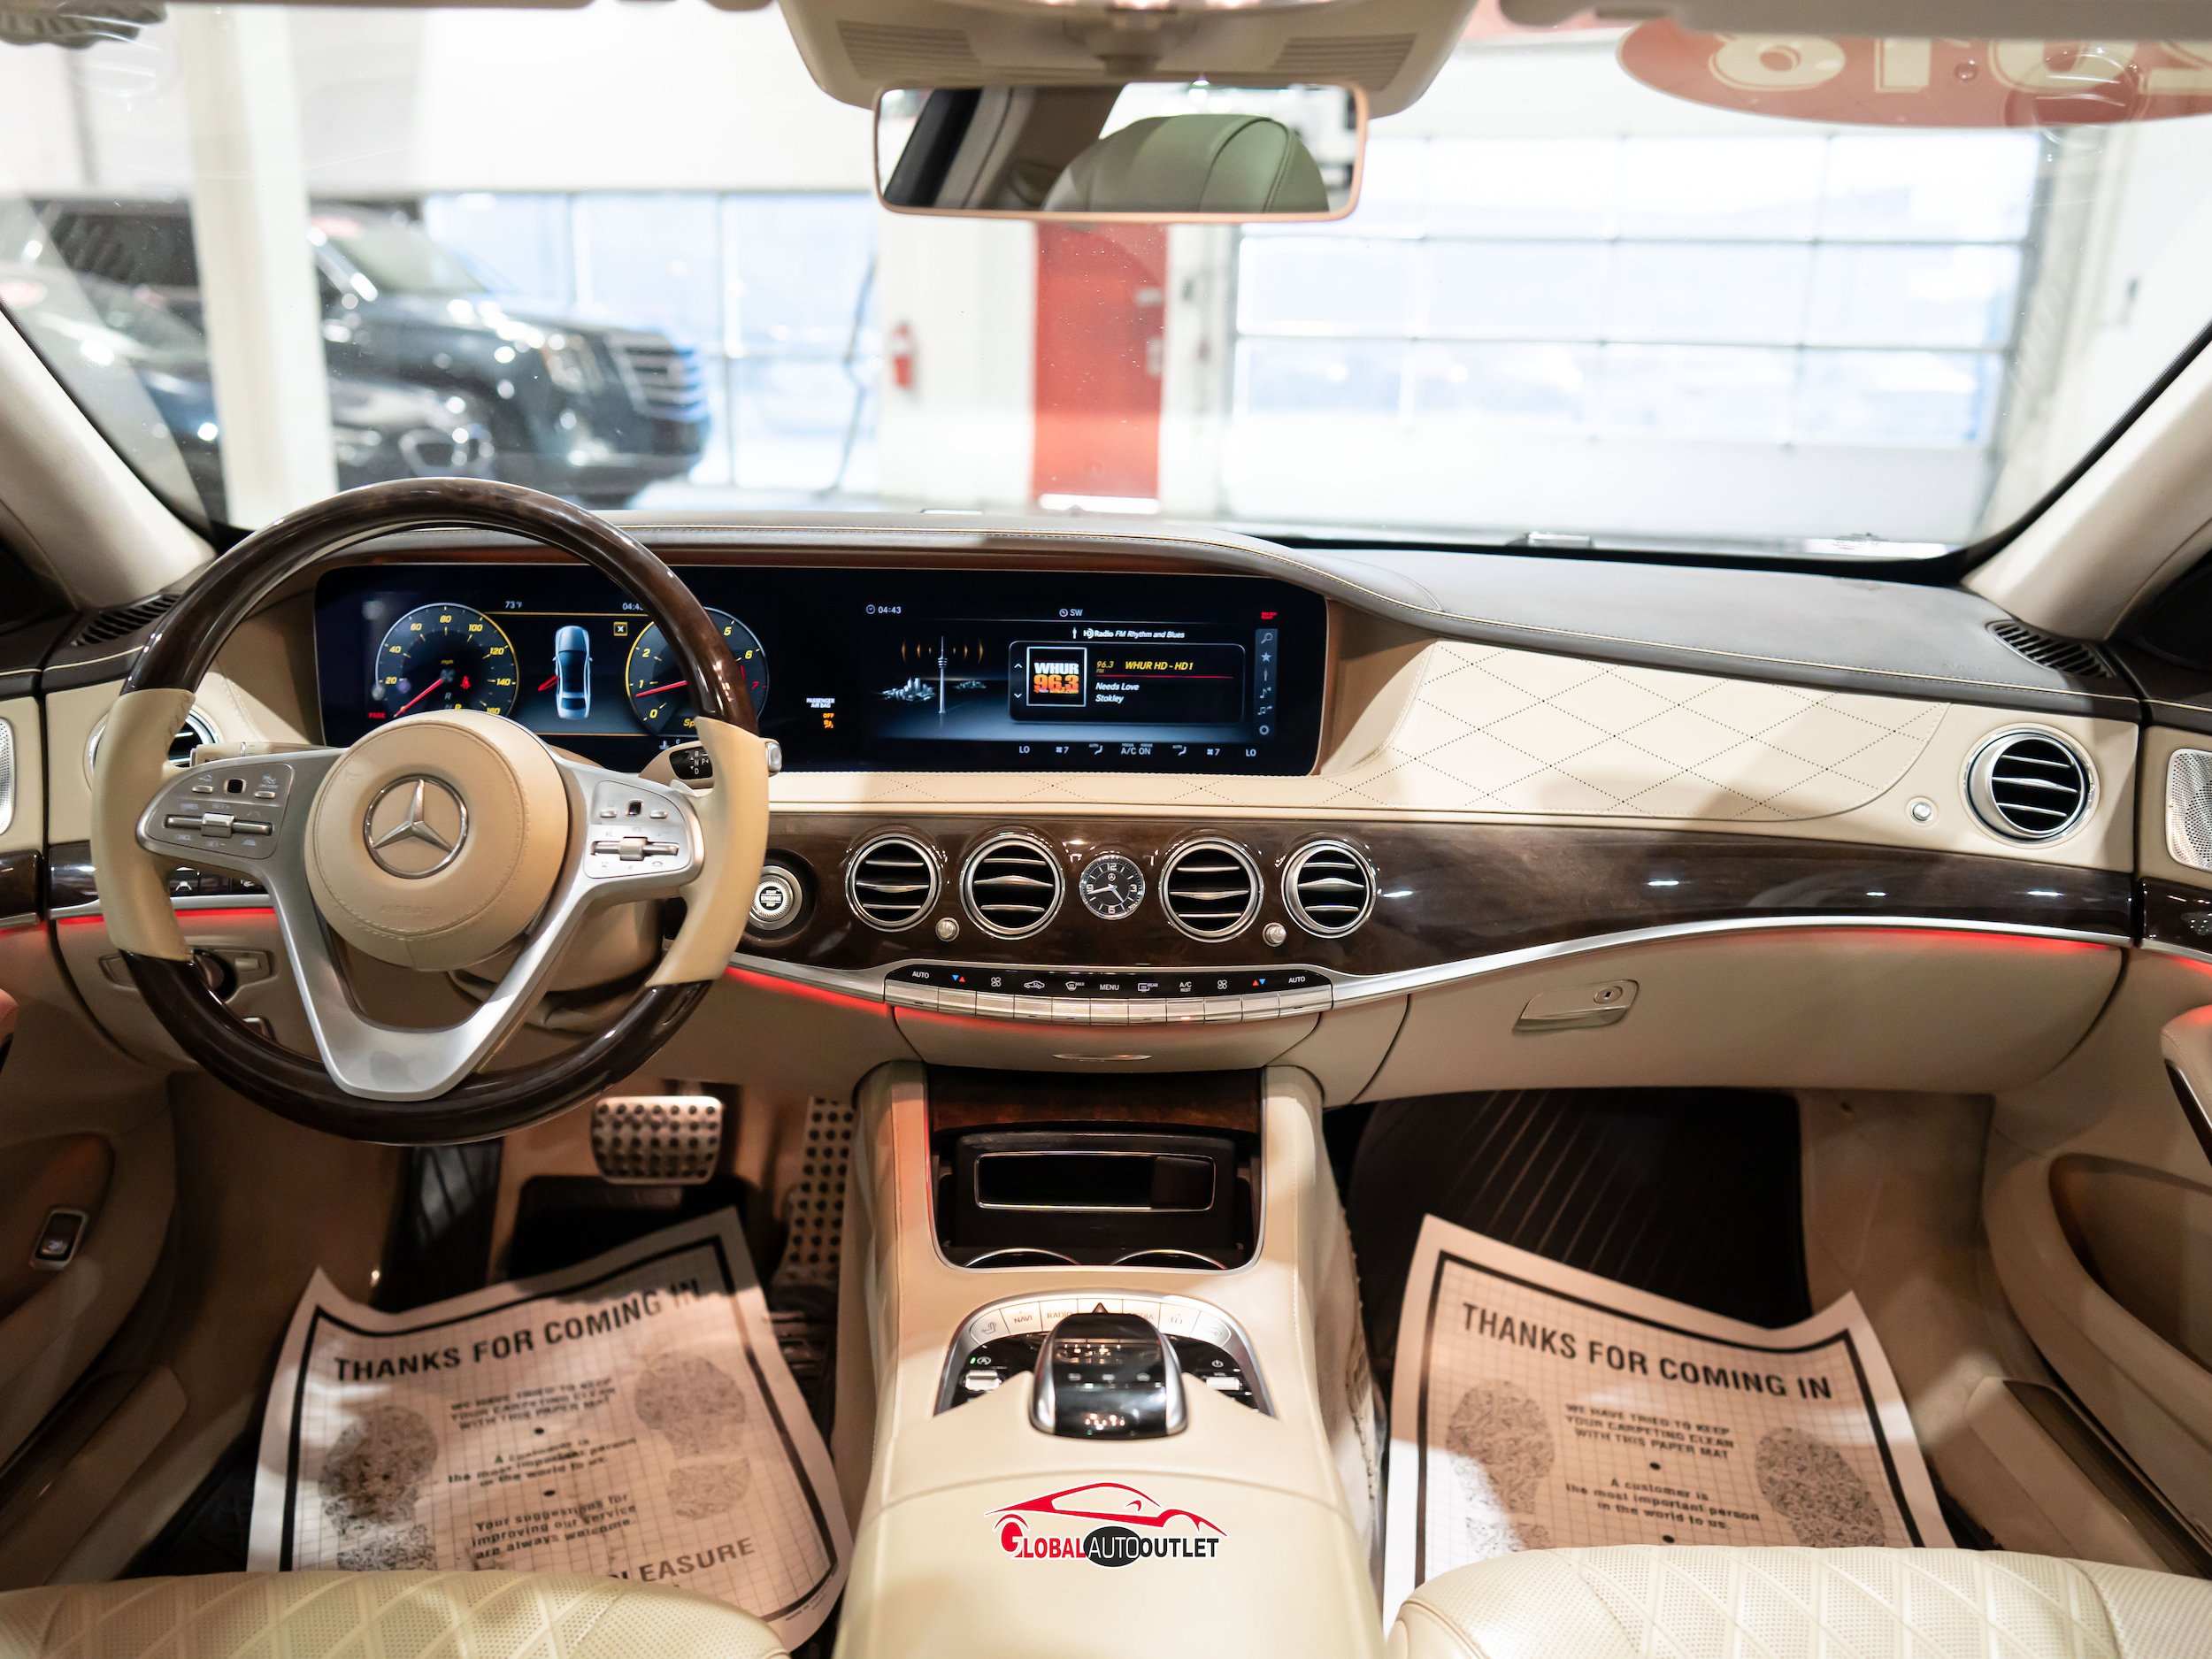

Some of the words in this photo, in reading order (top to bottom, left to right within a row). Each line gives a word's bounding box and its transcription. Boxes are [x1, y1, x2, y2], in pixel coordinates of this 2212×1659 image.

[469, 623, 483, 632] 100
[723, 626, 732, 636] 5
[1127, 630, 1152, 639] Rhythm
[389, 645, 402, 654] 40
[489, 647, 504, 656] 120
[641, 649, 651, 658] 2
[745, 650, 753, 659] 6
[1033, 662, 1079, 674] WHUR
[1096, 660, 1114, 669] 96.3
[1125, 661, 1153, 670] WHUR
[1154, 662, 1168, 671] HD
[1174, 662, 1194, 671] HD1
[385, 676, 397, 685] 20
[496, 678, 511, 687] 140
[638, 680, 644, 688] 1
[1033, 674, 1079, 691] 96.3
[752, 681, 759, 690] 7
[1095, 694, 1125, 704] Stokley
[649, 709, 658, 719] 0
[1108, 863, 1117, 872] 12
[1130, 884, 1138, 893] 3
[1099, 983, 1120, 992] MENU
[1014, 1315, 1033, 1324] NAVI
[334, 1348, 461, 1381] THANKS
[472, 1330, 534, 1363] FOR
[543, 1289, 661, 1345] COMING
[669, 1278, 701, 1307] IN
[1463, 1302, 1577, 1359] THANKS
[1589, 1340, 1649, 1376] FOR
[1659, 1357, 1788, 1397] COMING
[1798, 1377, 1832, 1400] IN
[1610, 1478, 1619, 1488] A
[1624, 1480, 1690, 1499] customer
[1696, 1492, 1709, 1502] is
[1566, 1483, 1588, 1495] the
[1594, 1488, 1629, 1501] most
[1633, 1494, 1704, 1513] important
[1709, 1506, 1760, 1522] person
[476, 1517, 510, 1532] Your
[515, 1500, 604, 1525] suggestions
[609, 1494, 628, 1505] for
[1597, 1502, 1611, 1512] in
[1616, 1503, 1639, 1516] the
[1643, 1508, 1685, 1523] world
[1689, 1514, 1703, 1525] to
[472, 1522, 549, 1548] improving
[555, 1519, 578, 1530] our
[583, 1505, 637, 1525] service
[475, 1548, 501, 1560] are
[507, 1534, 560, 1552] always
